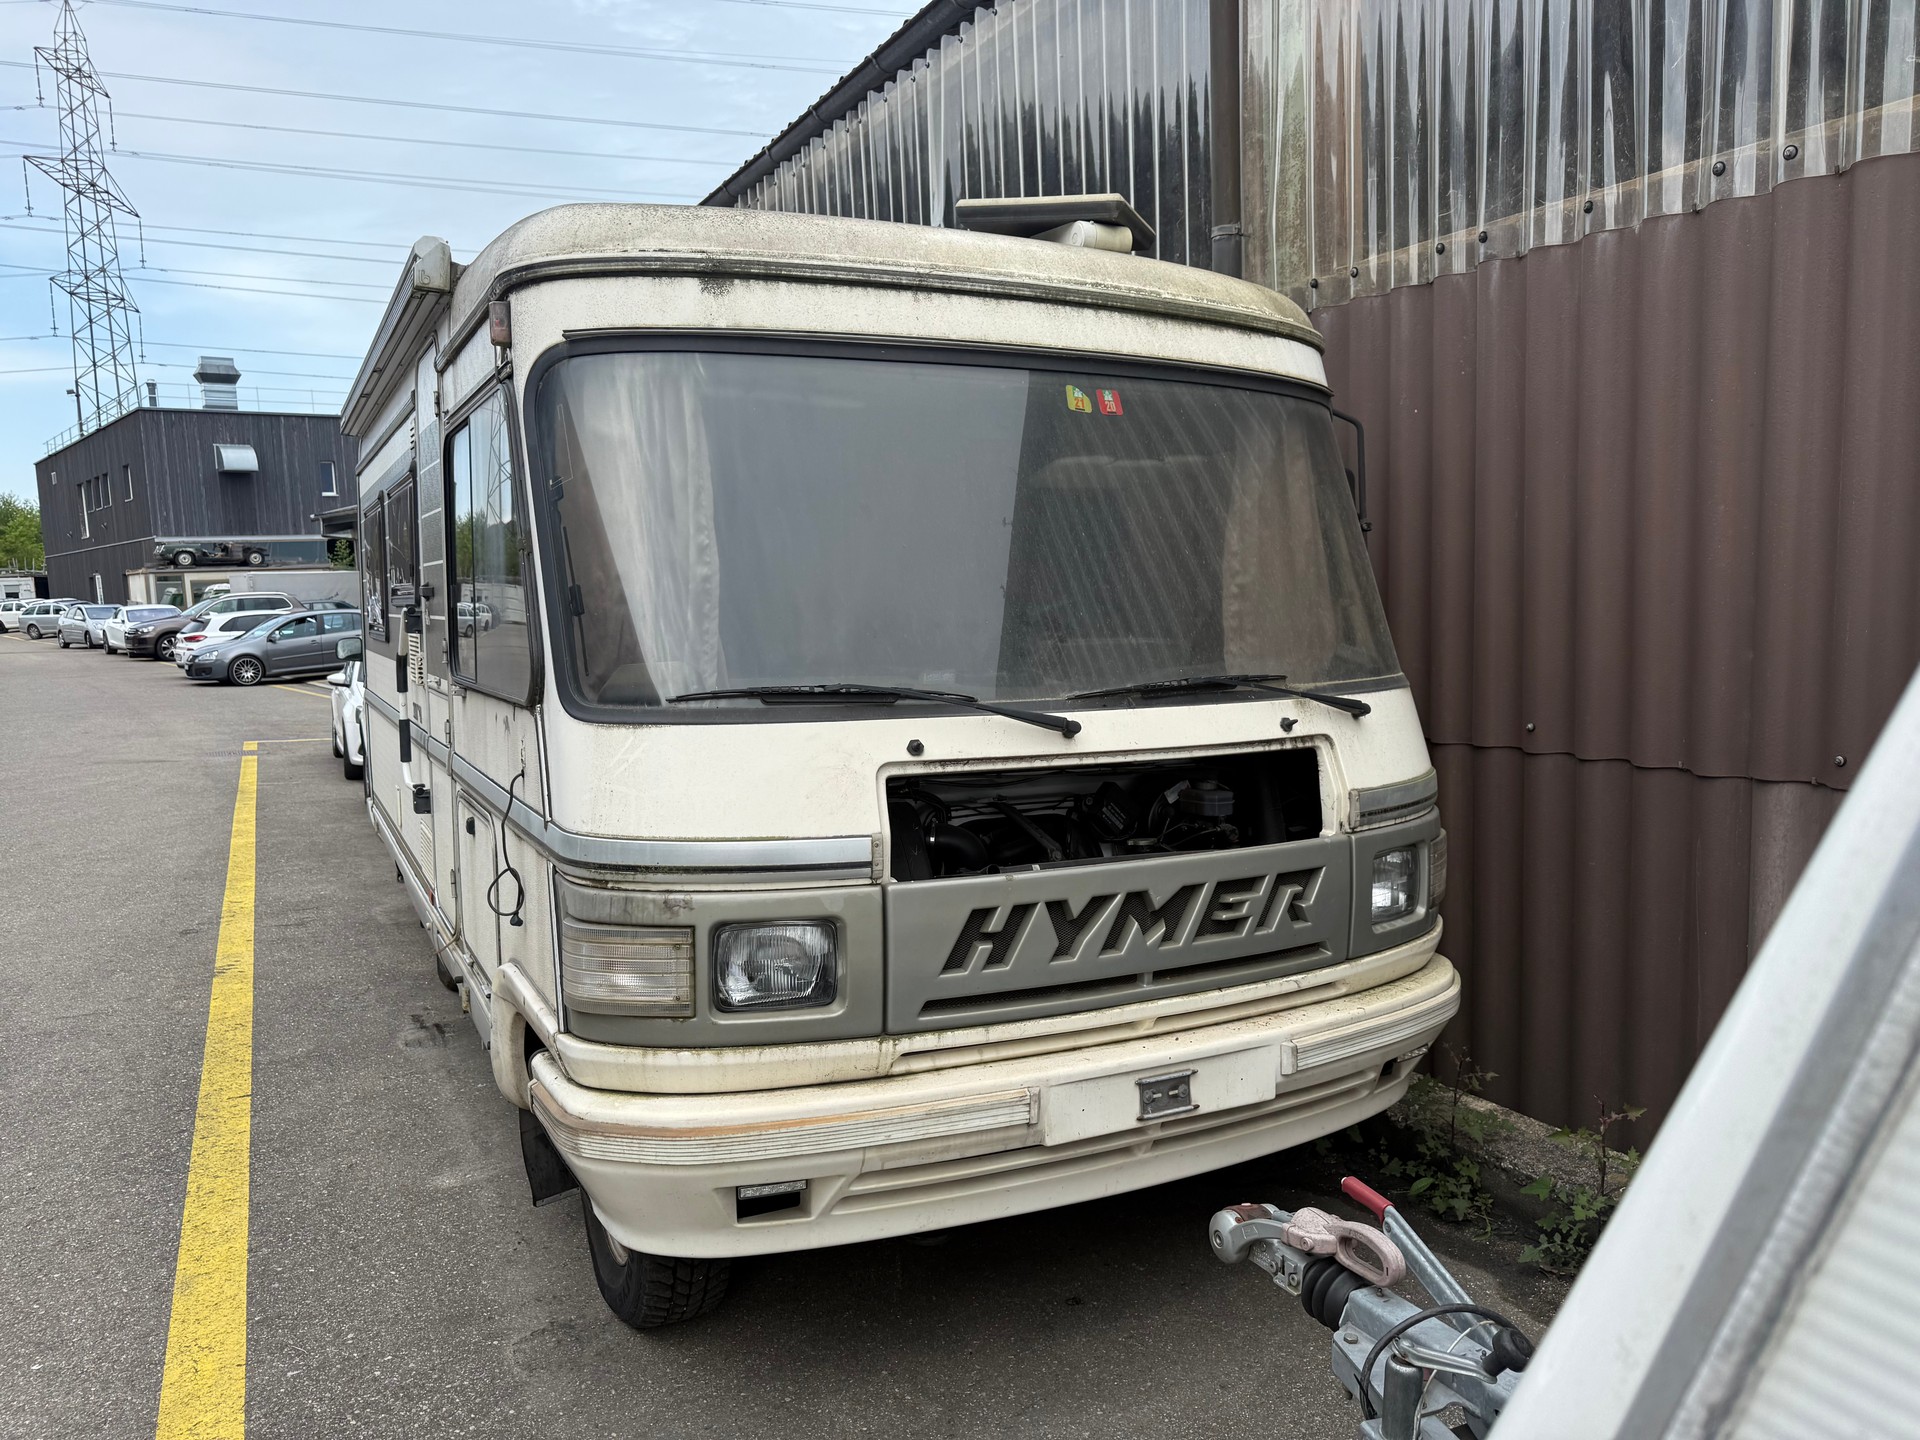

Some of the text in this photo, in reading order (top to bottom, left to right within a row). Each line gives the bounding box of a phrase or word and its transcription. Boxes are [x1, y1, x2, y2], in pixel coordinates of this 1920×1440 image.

[1074, 398, 1085, 409] 21
[1105, 401, 1116, 412] 20
[938, 866, 1327, 977] HYMER
